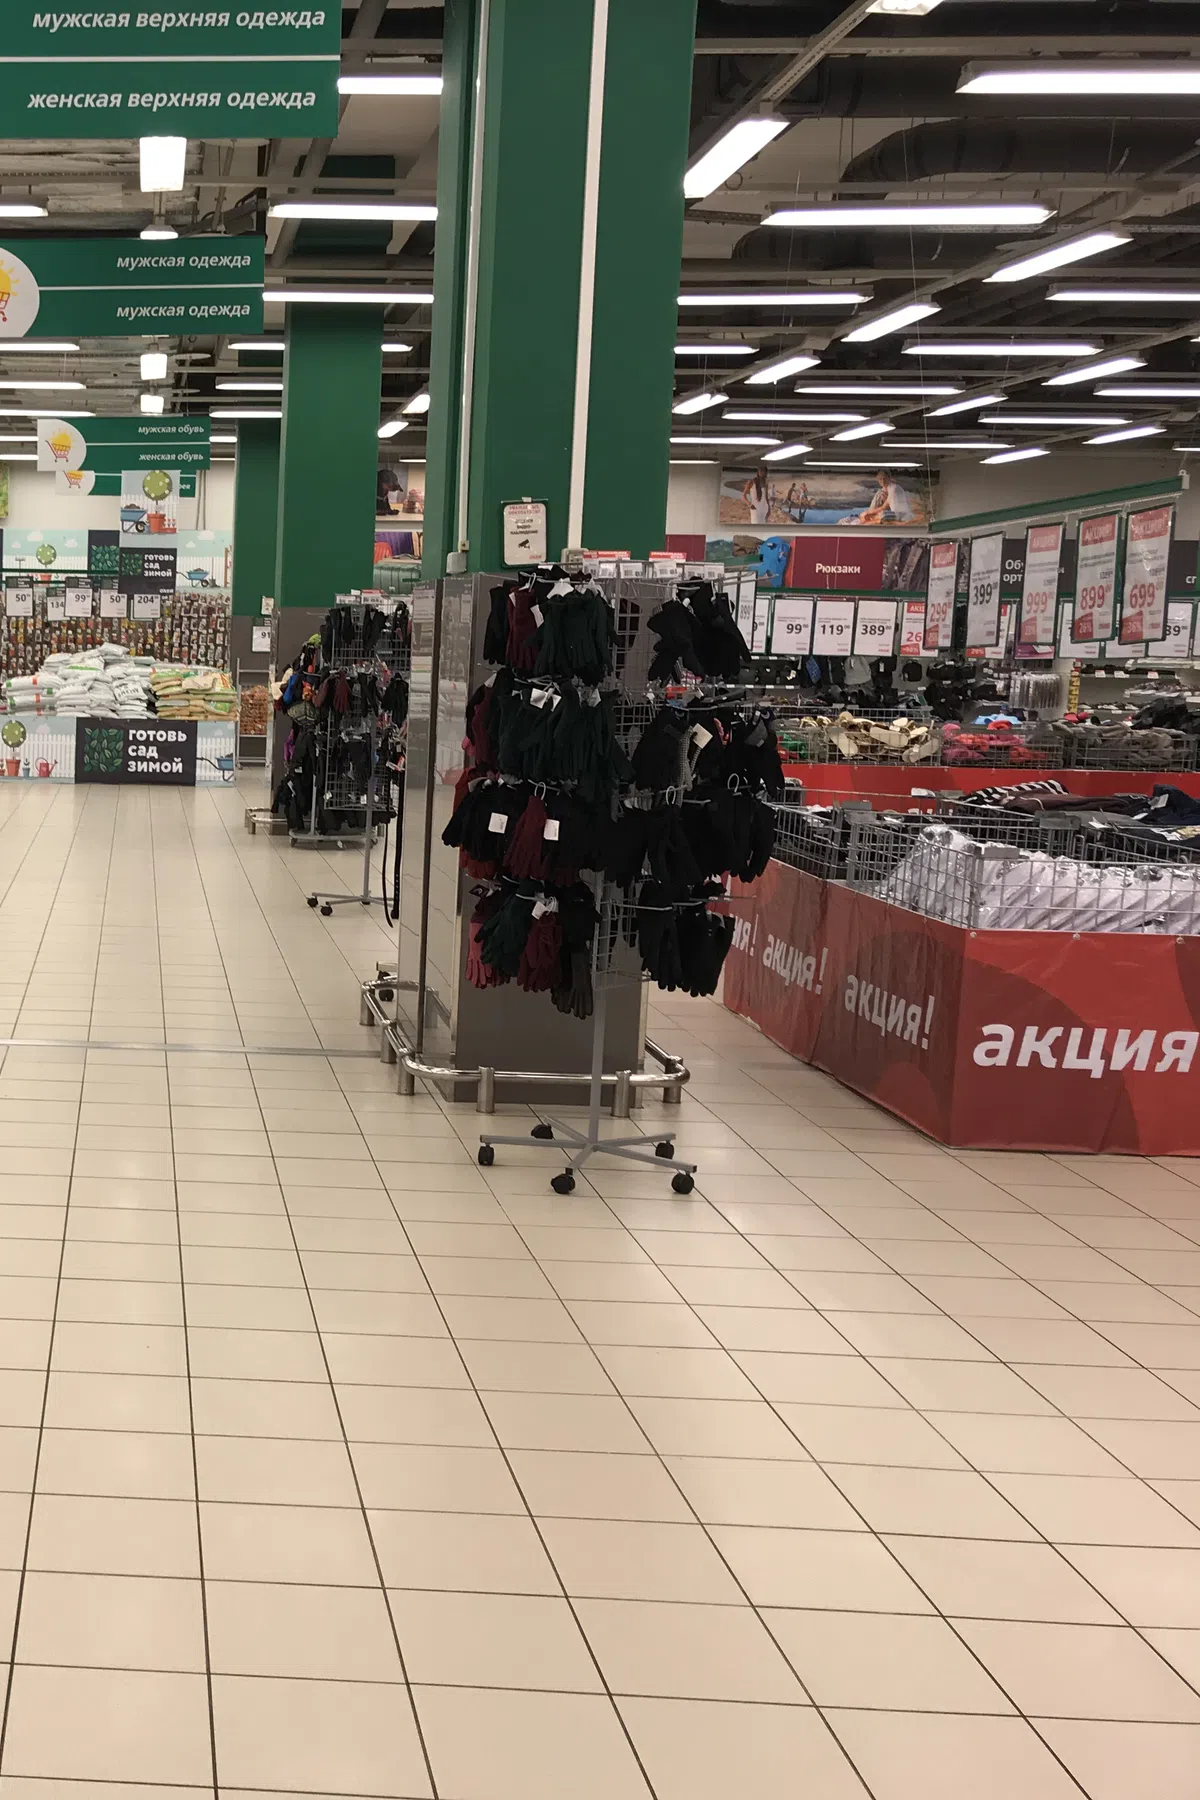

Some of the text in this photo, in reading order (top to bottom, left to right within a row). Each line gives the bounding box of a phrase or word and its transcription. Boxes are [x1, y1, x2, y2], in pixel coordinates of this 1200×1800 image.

[32, 8, 326, 34] мужская верхняя одежда
[27, 88, 317, 112] женская верхняя одежда
[116, 254, 252, 270] мужская одежда
[116, 303, 251, 320] мужская одежда
[138, 424, 205, 435] мужская обувь
[138, 452, 204, 462] женская обувь
[144, 553, 175, 561] готовь
[144, 562, 160, 570] сад
[144, 569, 173, 577] зимой
[815, 562, 861, 574] Рюкзаки
[906, 631, 923, 642] 26
[128, 729, 187, 743] готовь
[128, 743, 159, 759] сад
[127, 757, 183, 774] зимой
[732, 913, 936, 1051] ия! акция! акция!
